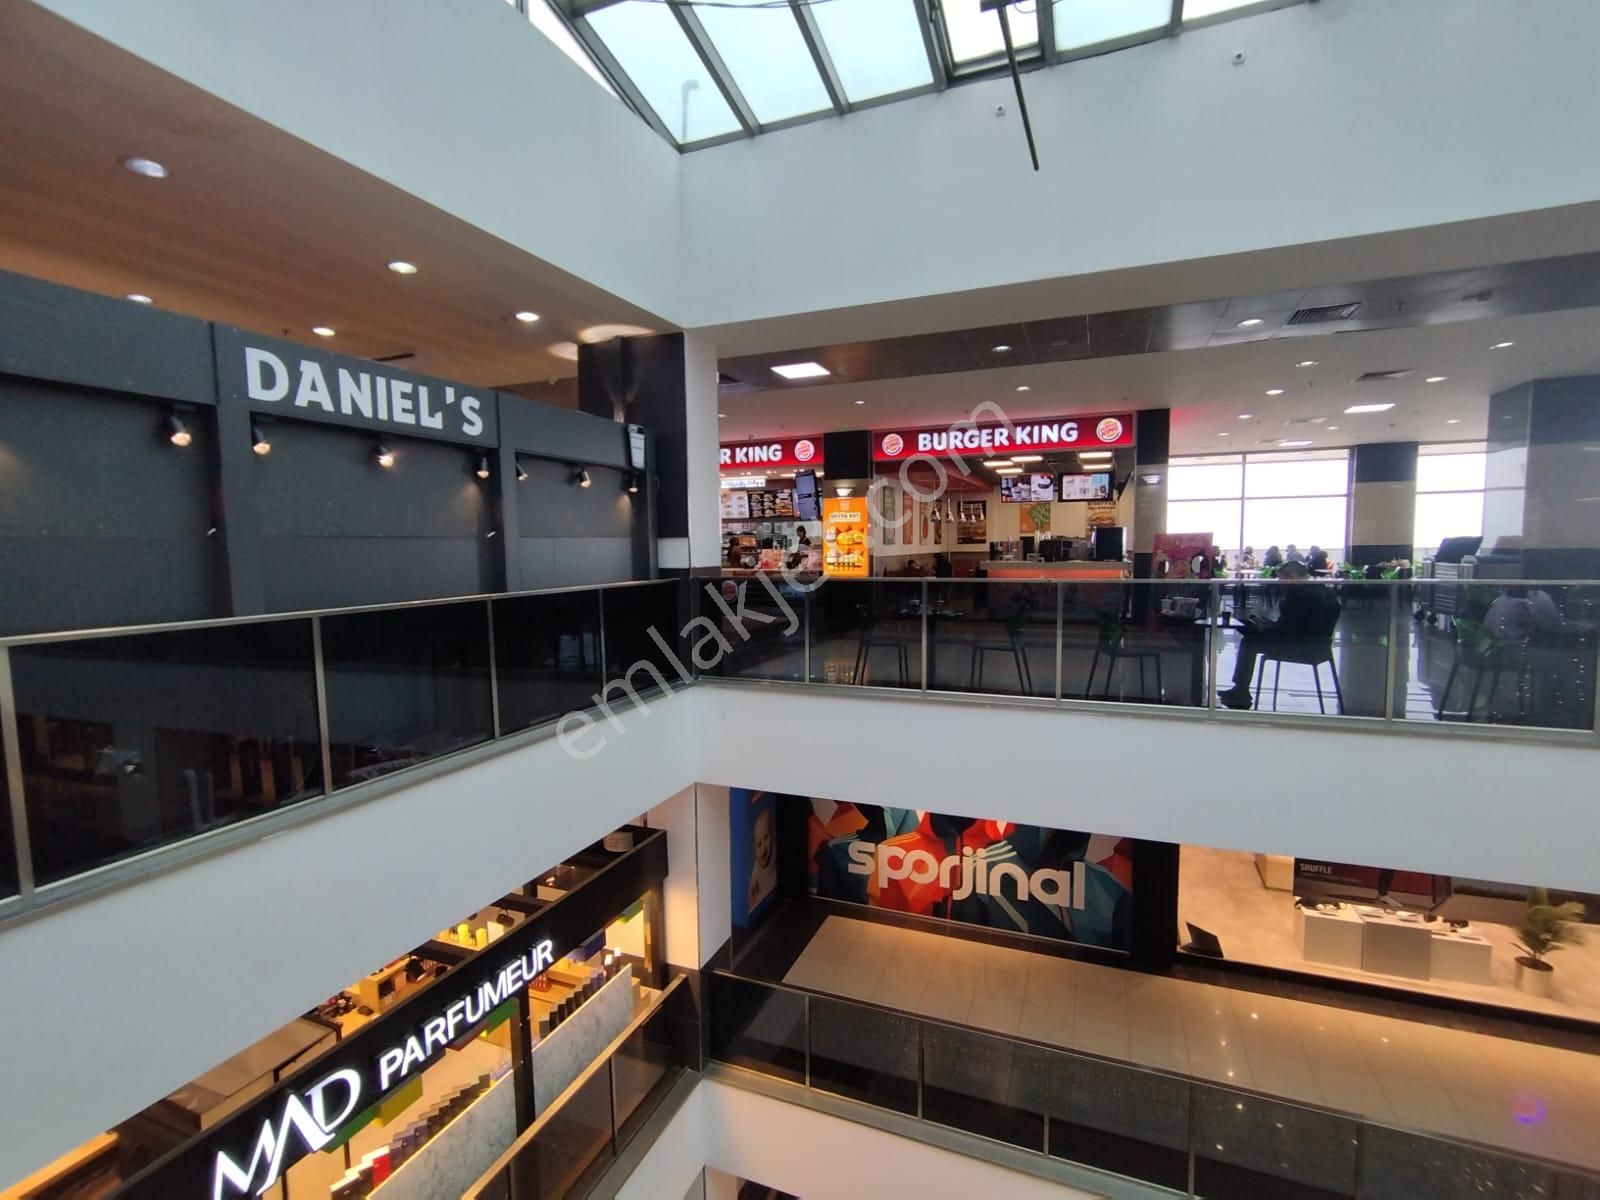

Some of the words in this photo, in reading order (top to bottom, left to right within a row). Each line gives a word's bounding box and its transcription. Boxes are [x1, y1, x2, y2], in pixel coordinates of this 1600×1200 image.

[244, 346, 484, 437] DANIEL'S
[735, 443, 783, 464] KING
[918, 428, 1009, 451] BURGER
[1015, 422, 1079, 445] KING
[847, 841, 1086, 910] sporjinal
[1300, 863, 1333, 875] SHUFFLE
[379, 939, 554, 1091] PARFUMEUR
